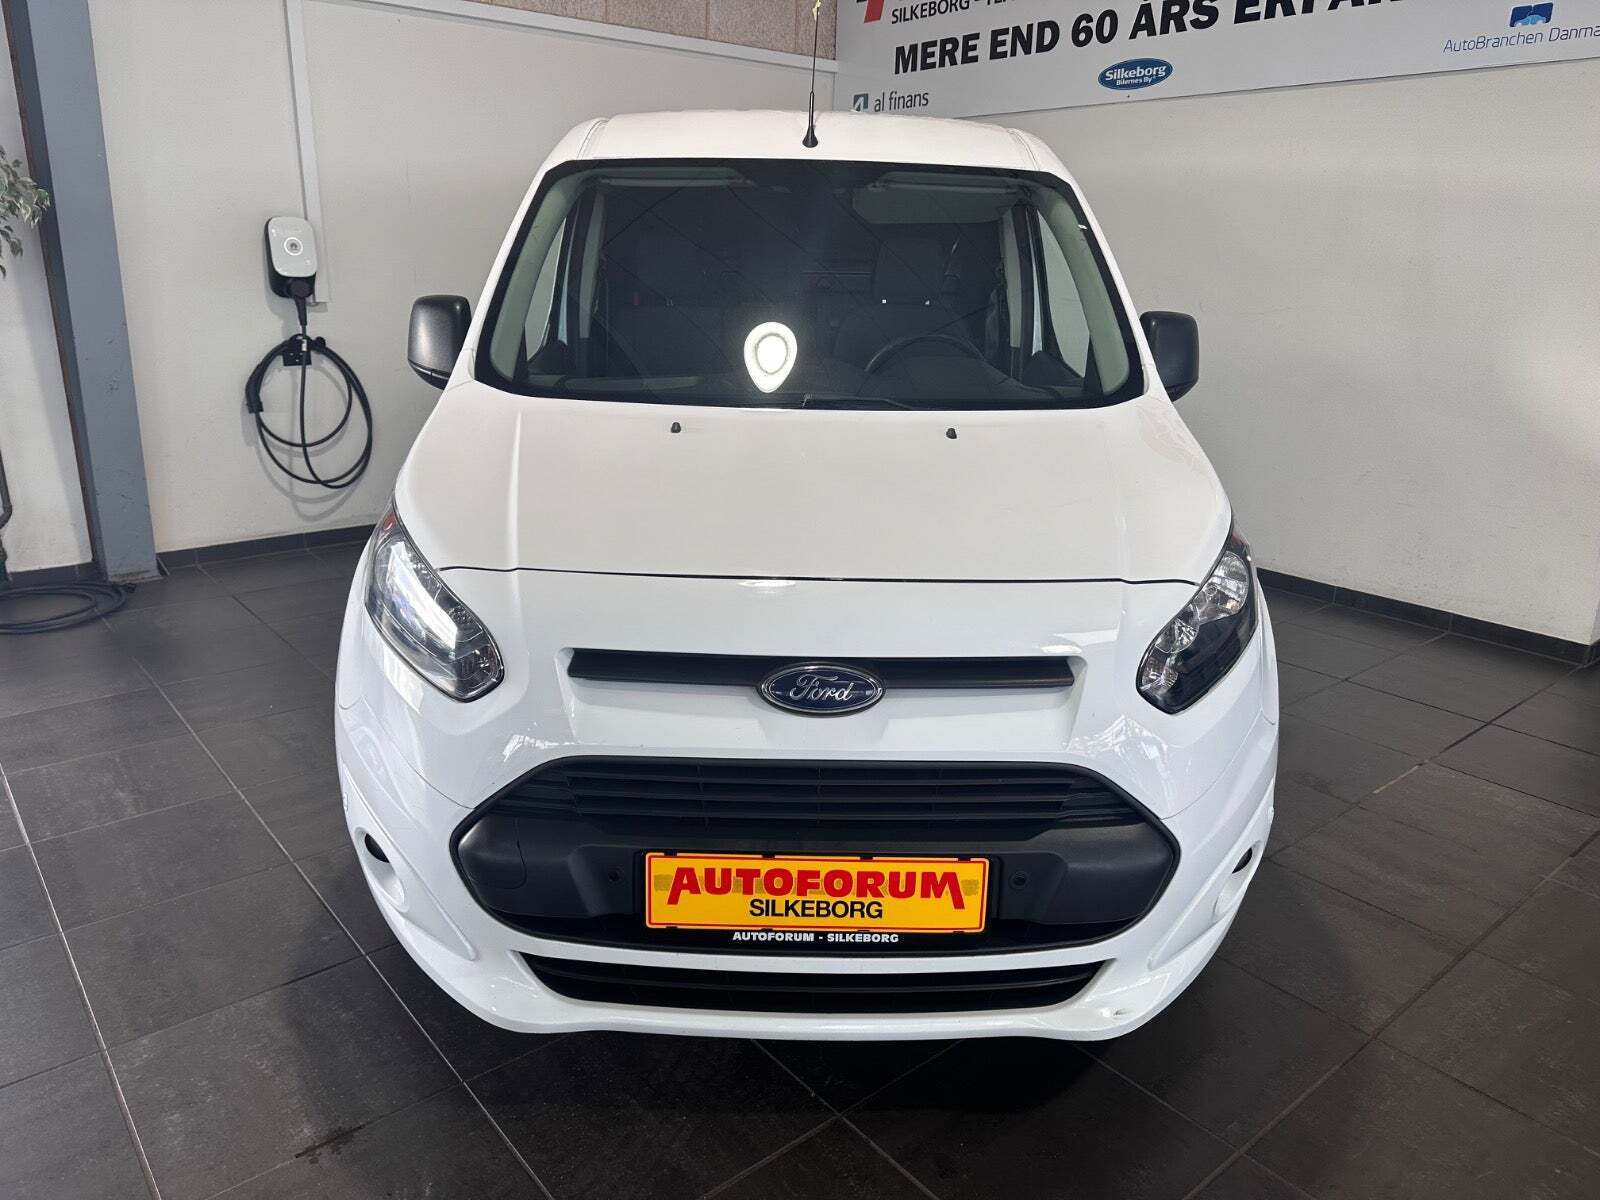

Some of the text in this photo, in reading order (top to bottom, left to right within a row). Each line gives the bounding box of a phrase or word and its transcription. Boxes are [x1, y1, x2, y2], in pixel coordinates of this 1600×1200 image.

[891, 0, 970, 25] SILKEBORG
[894, 32, 980, 75] MERE
[989, 20, 1060, 61] END
[1070, 9, 1119, 48] 60
[1128, 0, 1220, 40] ÅRS
[1443, 31, 1544, 53] AutoBranchen
[1105, 65, 1167, 81] Silkeborg
[1143, 76, 1153, 84] By
[874, 90, 929, 112] al finans
[789, 673, 855, 701] Ford
[667, 866, 966, 910] AUTOFORUM
[749, 898, 883, 920] SILKEBORG
[732, 931, 815, 943] AUTOFORUM
[827, 933, 899, 943] SILKEBORG
